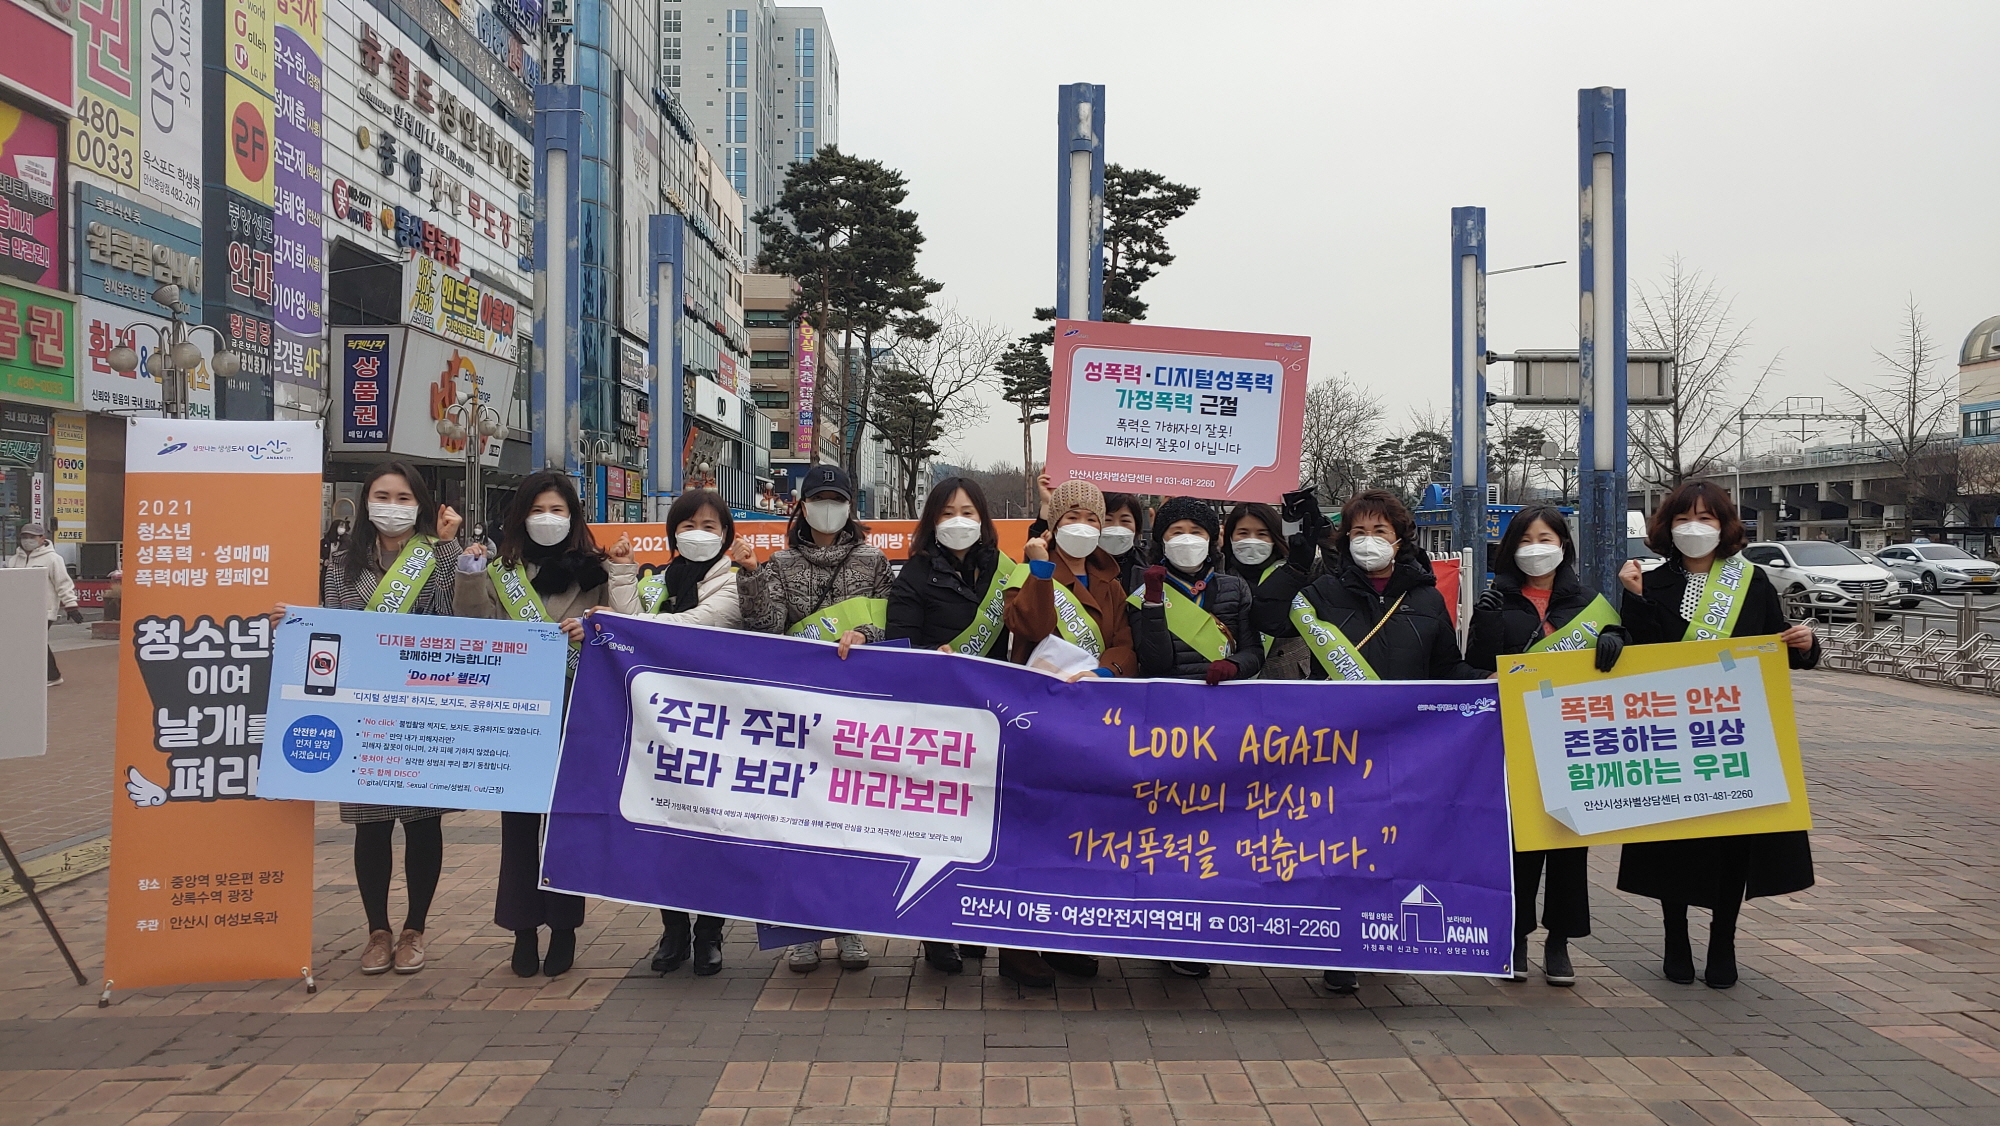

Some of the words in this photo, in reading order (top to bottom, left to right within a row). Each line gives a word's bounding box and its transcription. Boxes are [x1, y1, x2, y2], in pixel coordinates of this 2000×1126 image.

[247, 31, 267, 53] olleh
[360, 21, 435, 115] 뉴월드
[179, 70, 191, 108] OF
[78, 96, 135, 139] 480-
[77, 130, 133, 179] 0033
[439, 89, 531, 192] 성인나이트
[143, 150, 175, 179] 옥스포드
[170, 186, 201, 213] 482-2477
[378, 130, 424, 193] 중앙
[468, 190, 512, 249] 무도장
[11, 236, 50, 269] 안경원!
[228, 240, 274, 306] 안과
[414, 290, 434, 315] 7958
[440, 273, 480, 326] 핸드폰
[480, 293, 515, 340] 아울렛
[230, 314, 271, 346] 황금당
[139, 345, 151, 379] &
[304, 347, 321, 381] 4F
[131, 396, 143, 407] 국내
[353, 356, 380, 426] 상품권
[1115, 388, 1192, 413] 가정폭력
[1200, 394, 1238, 417] 근절
[57, 430, 84, 440] EXCHANGE
[1116, 417, 1151, 434] 폭력은
[1154, 421, 1201, 435] 가해자의
[1205, 423, 1232, 438] 잘못!
[1105, 436, 1152, 450] 피해자의
[1155, 438, 1190, 453] 잘못이
[1194, 440, 1242, 456] 아닙니다
[1069, 469, 1153, 484] 안산시성차별상담센터
[1164, 476, 1216, 488] 031-481-2260
[138, 500, 192, 516] 2021
[137, 523, 191, 541] 청소년
[633, 537, 669, 552] 2021
[136, 546, 193, 564] 성폭력
[213, 545, 270, 564] 성매매
[135, 569, 209, 588] 폭력예방
[214, 568, 270, 586] 캠페인
[1703, 590, 1735, 632] 여성이
[137, 618, 277, 663] 청소년
[419, 637, 456, 651] 성범죄
[460, 639, 488, 653] 근절'
[492, 641, 528, 655] 캠페인
[399, 650, 442, 663] 함께하면
[445, 654, 502, 667] 가능합니다!
[187, 664, 251, 695] 이여
[457, 672, 490, 686] 챌린지
[412, 696, 438, 706] 하지도,
[440, 698, 467, 708] 보지도,
[469, 700, 510, 711] 공유하지도
[512, 702, 540, 712] 마세요!
[1560, 693, 1616, 724] 폭력
[1623, 691, 1678, 720] 없는
[1685, 684, 1742, 715] 안산
[292, 727, 319, 738] 안전한
[320, 727, 336, 739] 사회
[295, 738, 312, 749] 먼저
[313, 738, 331, 750] 앞장
[832, 718, 977, 769] 관심주라
[1563, 722, 1678, 758] 존중하는
[1688, 717, 1746, 749] 일상
[289, 749, 333, 762] 서겠습니다.
[1239, 726, 1374, 780] AGAIN,
[1566, 756, 1682, 792] 함께하는
[1692, 750, 1751, 782] 우리
[406, 781, 428, 790] Sexual
[827, 767, 974, 817] 바라보라
[656, 797, 671, 809] 보라
[1131, 779, 1224, 815] 당신의
[1245, 780, 1335, 821] 관심이
[1583, 793, 1682, 813] 안산시성차별상담센터
[1693, 789, 1754, 803] 031-481-2260
[1068, 826, 1219, 880] 가정폭력을
[138, 879, 160, 891] 장소
[170, 875, 210, 890] 중앙역
[215, 872, 254, 887] 맞은편
[258, 869, 285, 885] 광장
[170, 890, 223, 907] 상록수역
[227, 888, 254, 903] 광장
[136, 919, 159, 932] 주관
[169, 914, 210, 931] 안산시
[213, 909, 280, 928] 여성보육과
[960, 896, 1012, 921] 안산시
[1017, 900, 1202, 934] 아동·여성안전지역연대
[1228, 915, 1341, 940] 031-481-2260
[1361, 922, 1399, 941] LOOK
[1446, 925, 1489, 944] AGAIN
